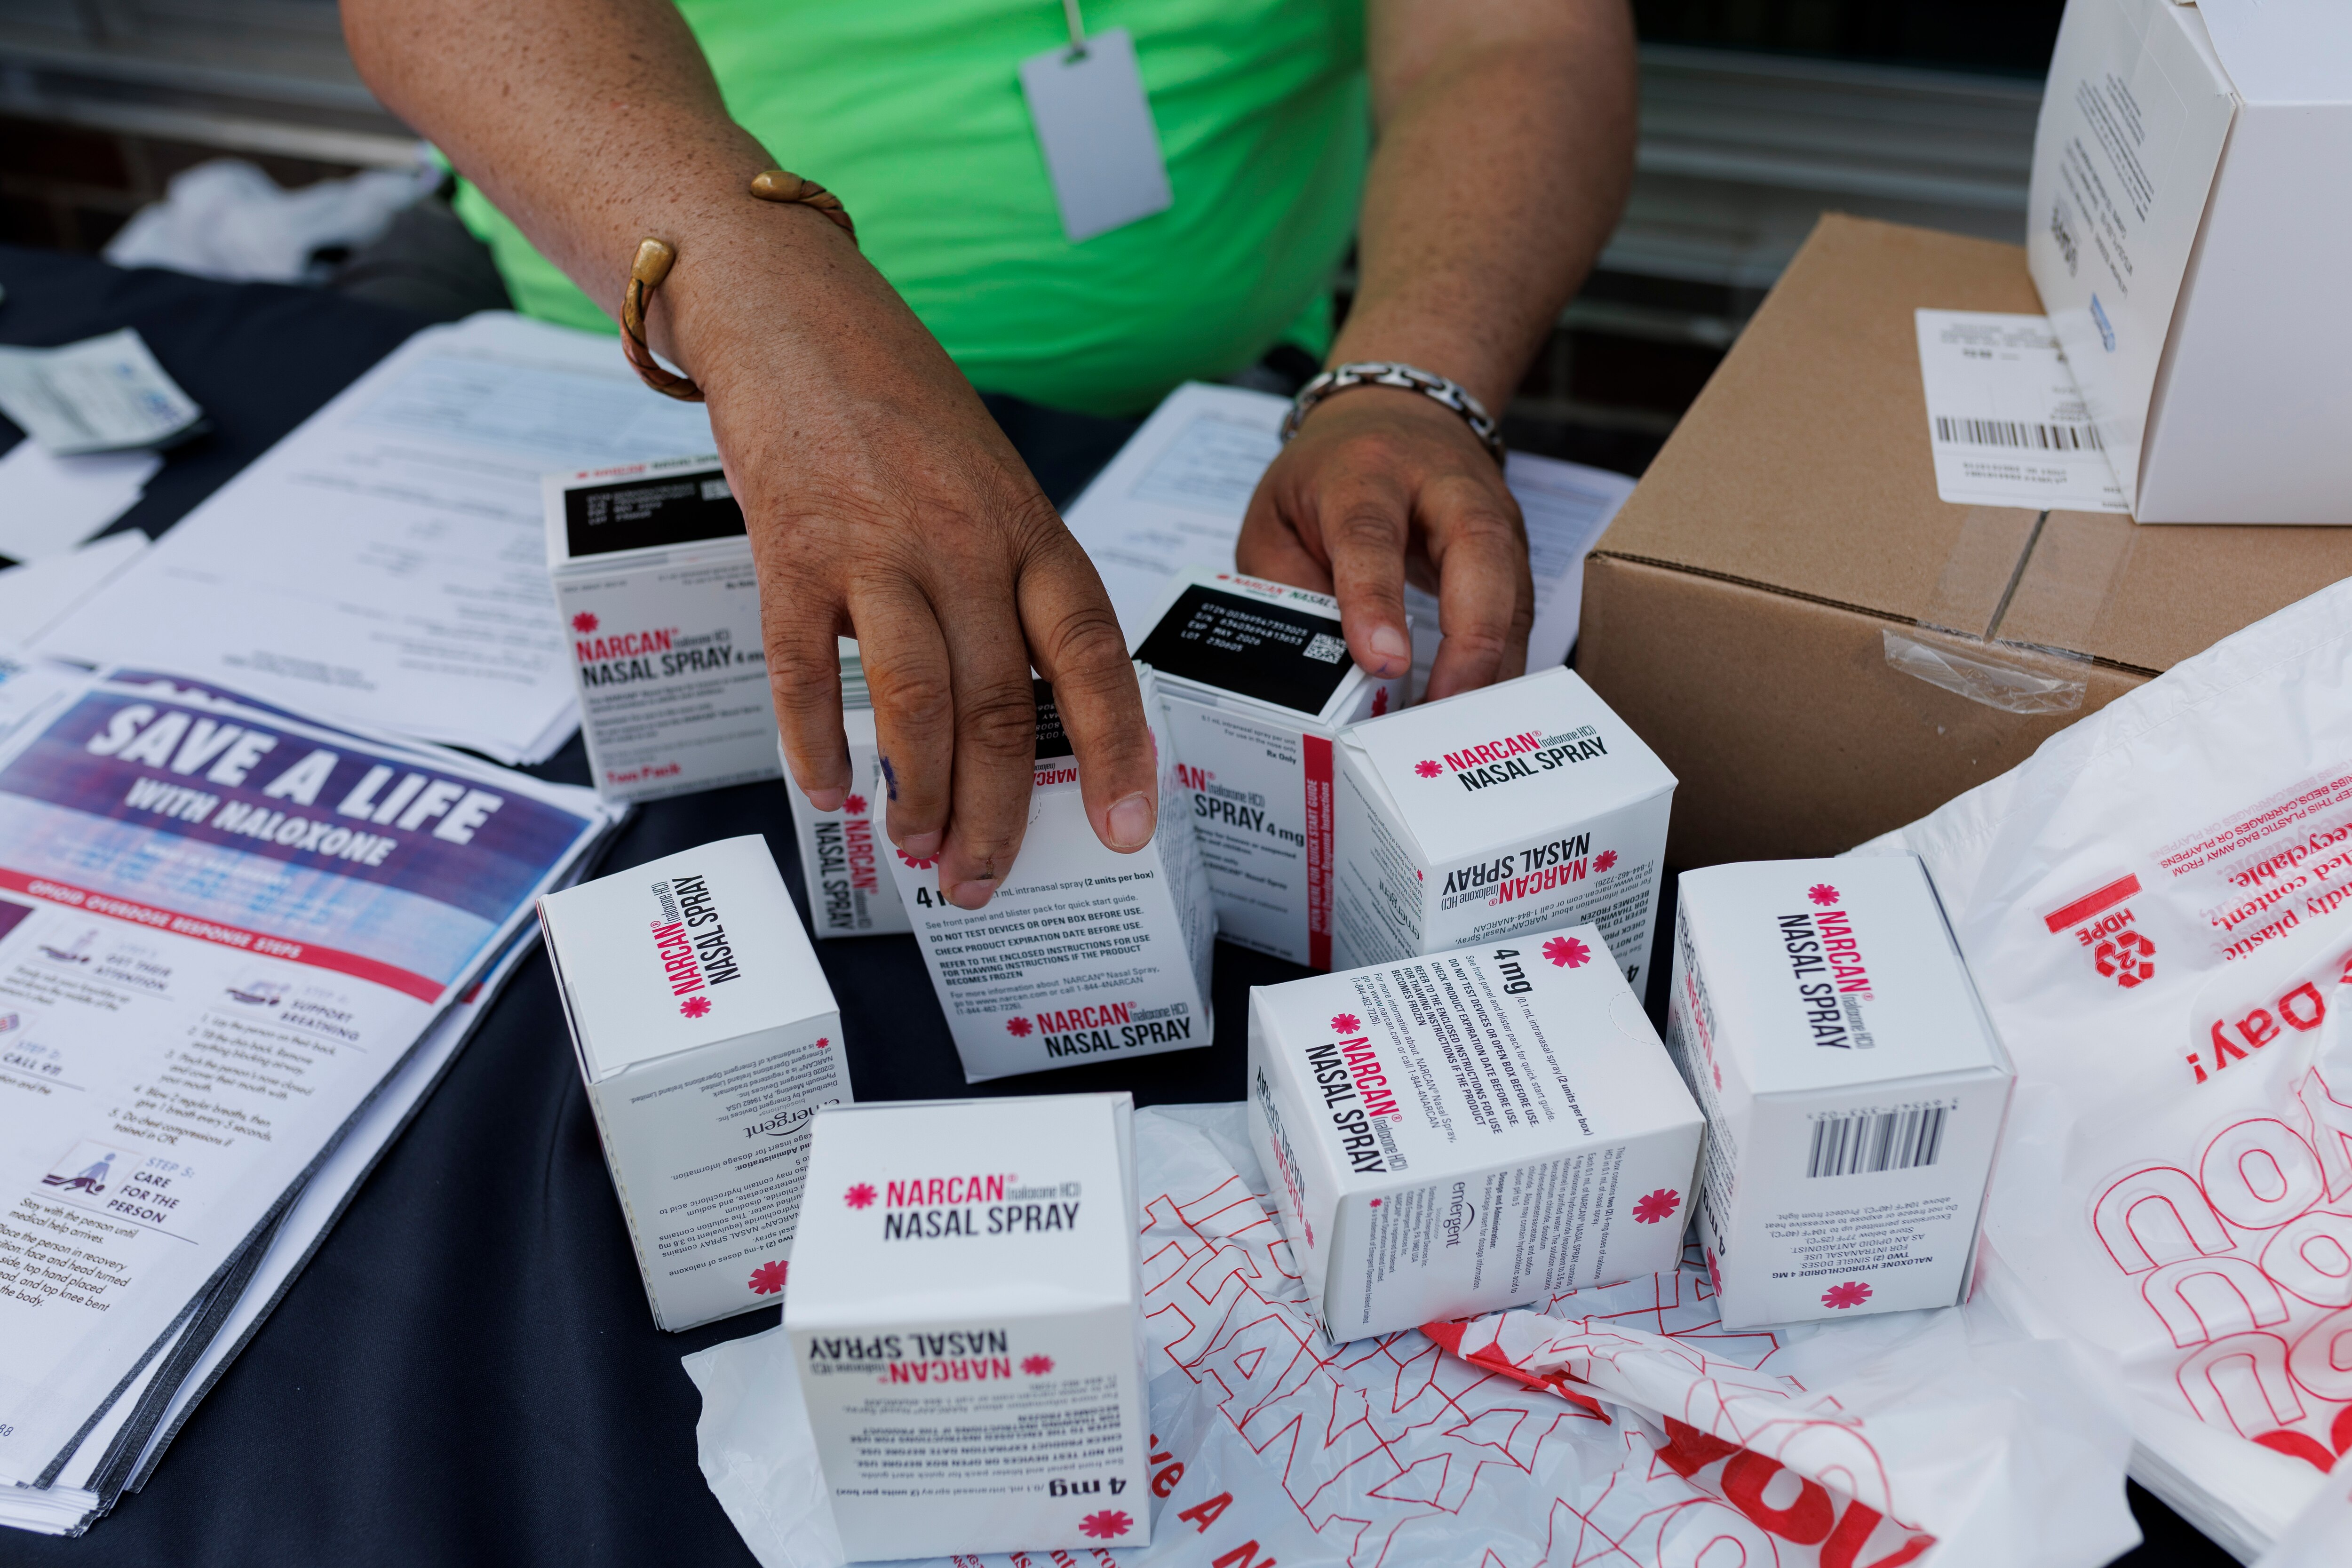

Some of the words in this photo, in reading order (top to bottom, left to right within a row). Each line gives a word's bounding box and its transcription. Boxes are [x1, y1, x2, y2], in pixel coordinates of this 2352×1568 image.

[581, 656, 663, 687] NASAL
[660, 645, 732, 677] SPRAY
[1537, 731, 1580, 748] (naloxone
[1266, 749, 1277, 758] Rx
[1278, 753, 1297, 765] Only
[1457, 757, 1540, 792] NASAL
[1534, 736, 1608, 770] SPRAY
[87, 705, 276, 787] SAVE
[264, 750, 337, 805] A
[337, 765, 502, 844] LIFE
[606, 770, 644, 783] Two
[641, 763, 681, 779] Pack
[1194, 793, 1265, 833] SPRAY
[1266, 822, 1276, 836] 4
[2233, 785, 2330, 836] BEDS,CARRIAGES
[2306, 797, 2334, 814] THIS
[126, 778, 218, 822] WITH
[213, 801, 396, 866] NALOXONE
[2260, 809, 2306, 836] PLASTIC
[2214, 830, 2234, 843] OR
[2235, 830, 2260, 847] BAG
[814, 821, 846, 882] NASAL
[1519, 831, 1590, 873] NASAL
[2157, 838, 2216, 868] PLAYPENS.
[2206, 842, 2234, 862] AWAY
[1441, 855, 1514, 896] SPRAY
[2171, 856, 2204, 877] FROM
[671, 874, 719, 927] SPRAY
[822, 879, 854, 930] SPRAY
[916, 886, 933, 908] 4
[1459, 883, 1499, 903] (naloxone
[1612, 889, 1650, 910] BECOMES
[2211, 875, 2307, 931] content,
[659, 892, 682, 924] (naloxone
[1580, 905, 1611, 922] FROZEN
[944, 931, 962, 941] NOT
[964, 928, 985, 938] TEST
[987, 922, 1025, 935] DEVICES
[1026, 920, 1040, 929] OR
[1041, 917, 1066, 927] OPEN
[1066, 914, 1087, 923] BOX
[1087, 909, 1122, 921] BEFORE
[1123, 907, 1144, 916] USE.
[2074, 907, 2135, 947] HDPE
[2222, 909, 2299, 960] plastic
[692, 923, 741, 986] NASAL
[1493, 949, 1520, 960] 4
[1777, 914, 1826, 979] NASAL
[1522, 1008, 1535, 1020] mL
[1799, 983, 1851, 1049] SPRAY
[1044, 1029, 1120, 1058] NASAL
[1120, 1016, 1191, 1048] SPRAY
[1430, 962, 1449, 982] CHECK
[1441, 981, 1466, 1012] PRODUCT
[1458, 1013, 1487, 1056] EXPIRATION
[1479, 1057, 1497, 1077] DATE
[1489, 1077, 1511, 1108] BEFORE
[1504, 1108, 1519, 1127] USE.
[1528, 1019, 1554, 1054] intranasal
[2186, 981, 2327, 1086] Day!
[1546, 1054, 1562, 1075] spray
[774, 1082, 804, 1095] Meeting,
[805, 1071, 836, 1086] Plymouth
[1555, 1075, 1568, 1083] (2
[742, 1096, 762, 1106] 19462
[1256, 1064, 1279, 1135] SPRAY
[1561, 1083, 1575, 1103] units
[725, 1102, 742, 1112] USA
[1304, 1043, 1356, 1109] NASAL
[1332, 1109, 1387, 1173] SPRAY
[1568, 1104, 1583, 1117] per
[1371, 1116, 1398, 1154] (naloxone
[1577, 1117, 1593, 1136] box)
[1280, 1122, 1305, 1202] NASAL
[134, 1171, 171, 1188] CARE
[1608, 1171, 1619, 1196] contains
[120, 1185, 150, 1201] FOR
[151, 1194, 179, 1209] THE
[1606, 1195, 1615, 1208] two
[19, 1197, 40, 1212] Stay
[43, 1206, 64, 1218] with
[64, 1210, 80, 1222] the
[77, 1218, 114, 1232] person
[114, 1227, 139, 1239] until
[107, 1199, 167, 1223] PERSON
[884, 1208, 977, 1240] NASAL
[987, 1202, 1079, 1234] SPRAY
[1442, 1181, 1465, 1249] emergent
[1604, 1208, 1614, 1217] (2)
[8, 1210, 51, 1227] medical
[47, 1219, 69, 1234] help
[69, 1229, 104, 1244] arrives.
[1600, 1217, 1612, 1232] 4-mg
[743, 1245, 764, 1254] 4-mg
[765, 1239, 776, 1249] (2)
[777, 1234, 794, 1243] two
[1599, 1232, 1610, 1249] doses
[717, 1251, 742, 1262] doses
[1799, 1260, 1834, 1269] DOSES.
[1836, 1256, 1871, 1266] SINGLE
[1880, 1256, 1933, 1268] NALOXONE
[1886, 1251, 1909, 1260] TWO
[668, 1262, 706, 1276] naloxone
[1593, 1255, 1605, 1280] naloxone
[1798, 1263, 1878, 1277] HYDROCHLORIDE
[1, 1284, 16, 1297] the
[15, 1289, 44, 1307] body.
[809, 1336, 902, 1360] SPRAY
[909, 1329, 1007, 1358] NASAL
[1108, 1477, 1126, 1495] 4
